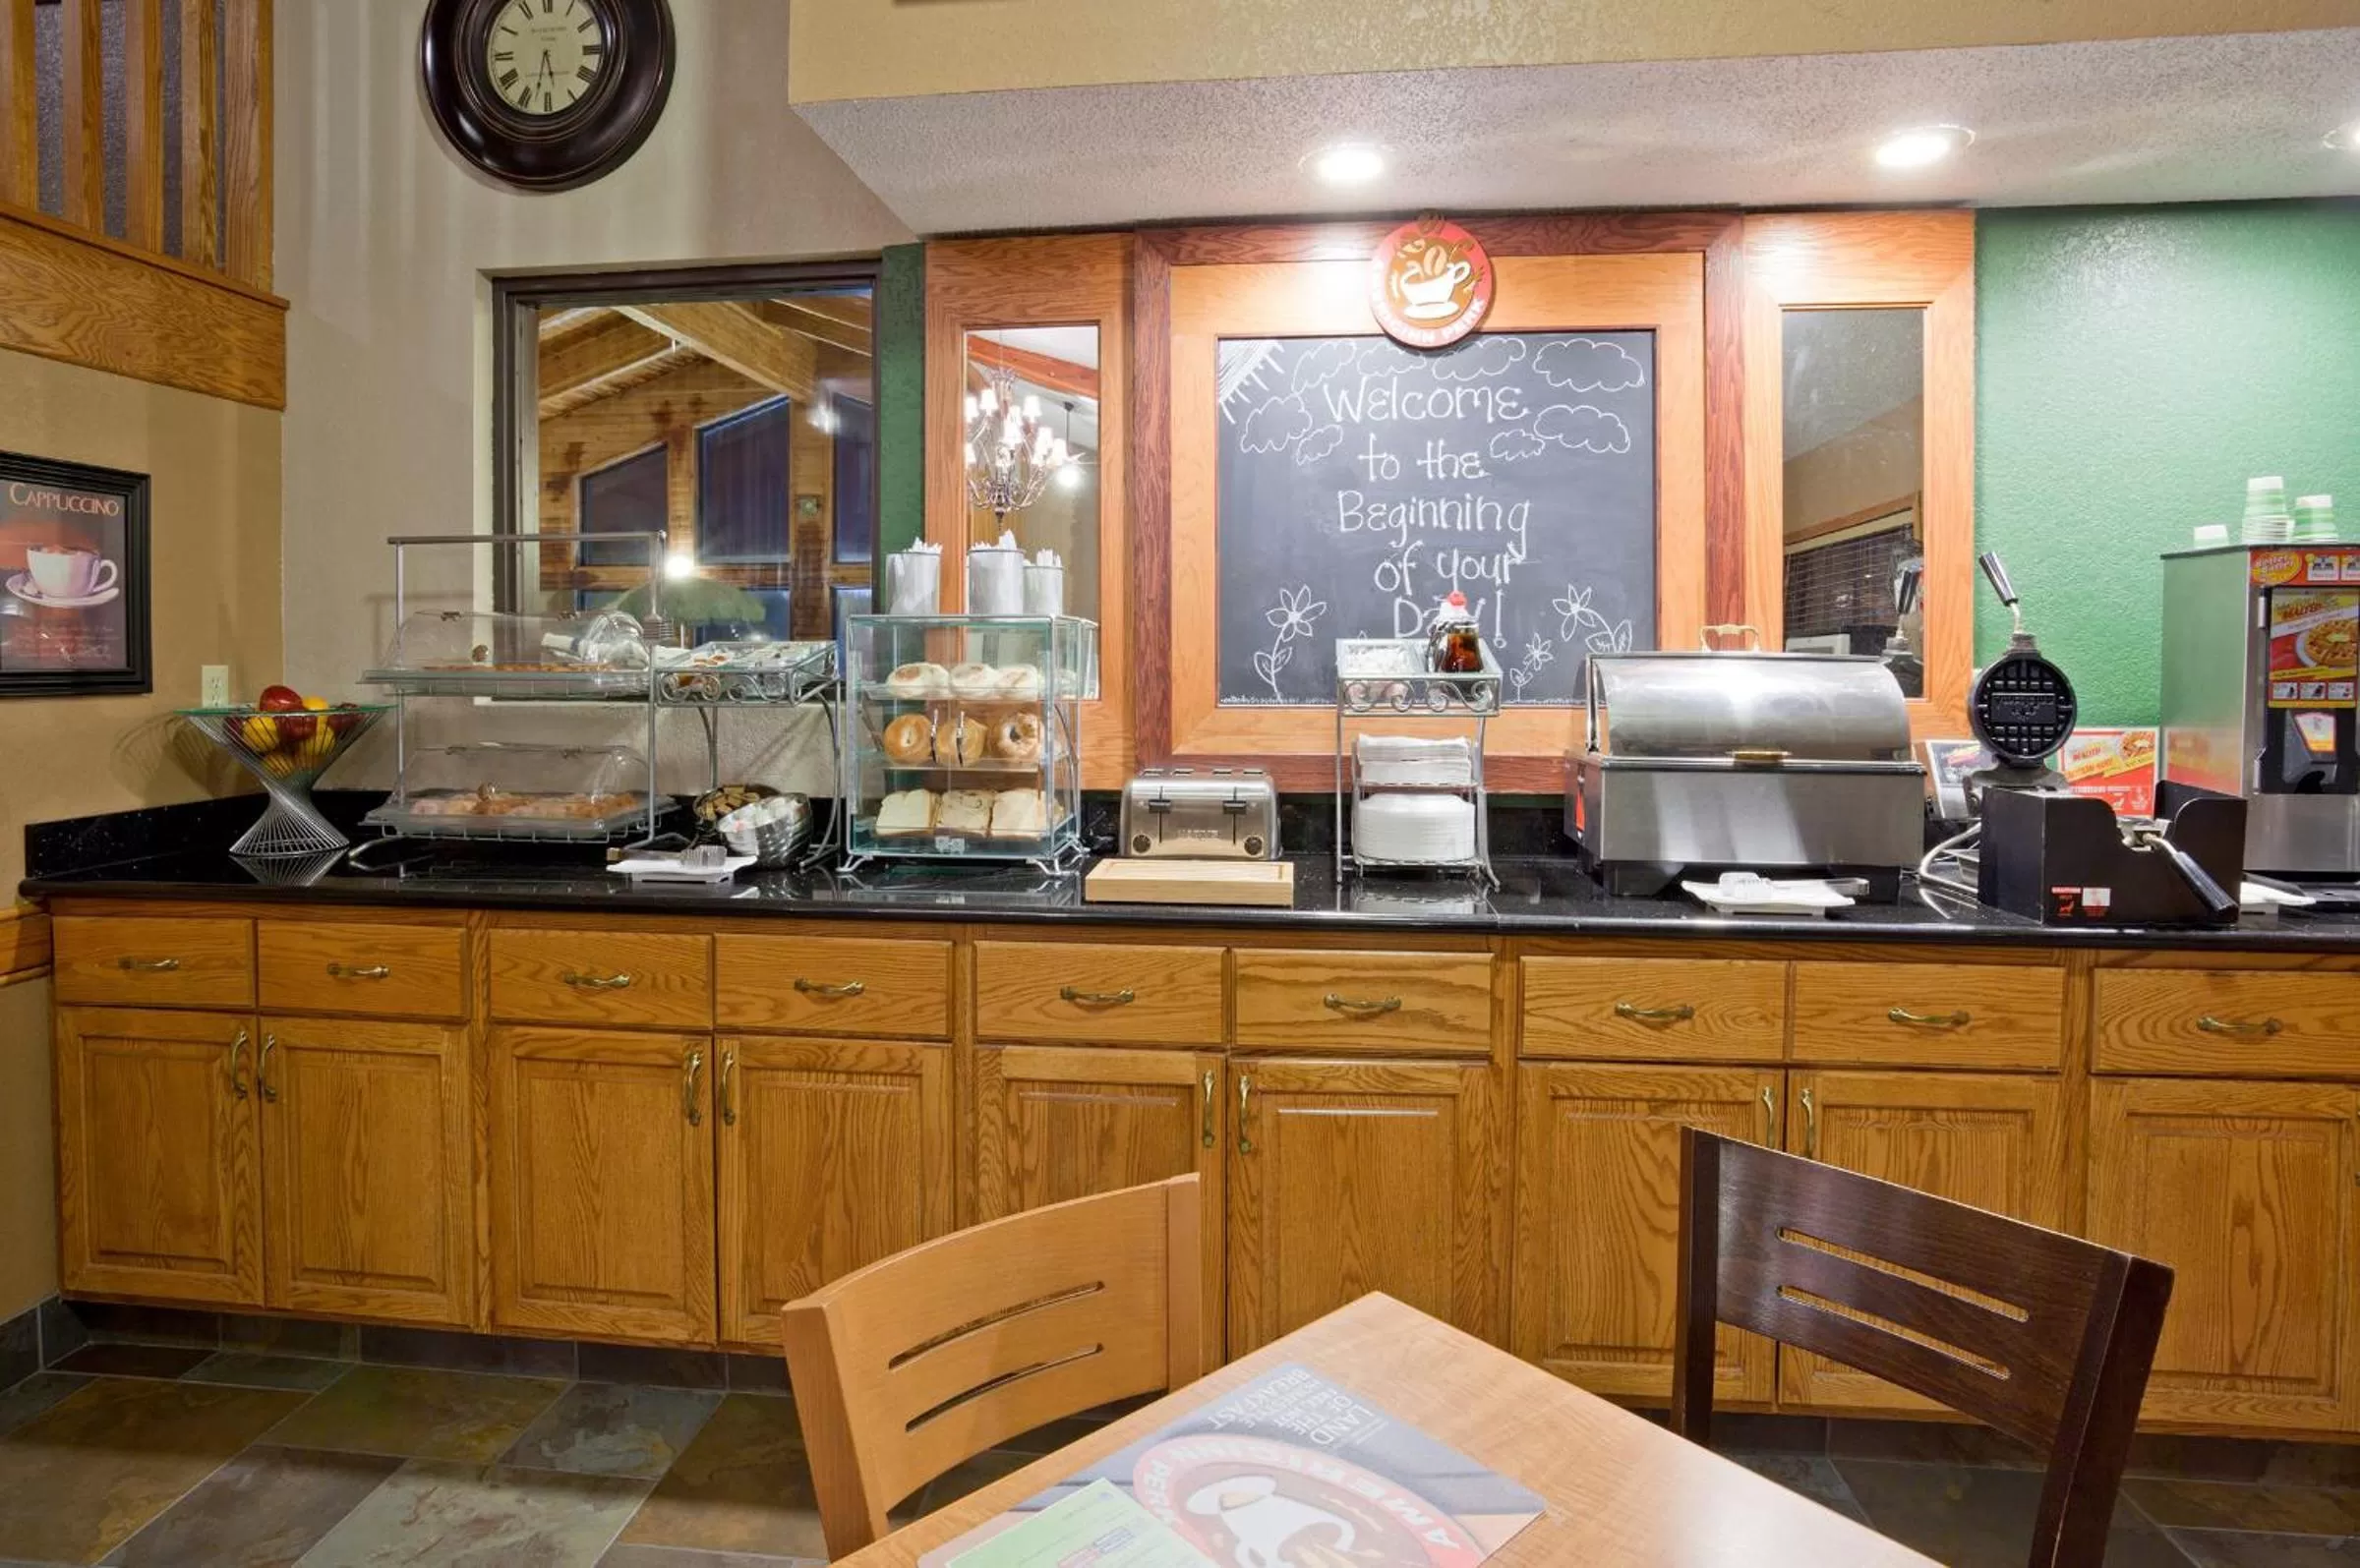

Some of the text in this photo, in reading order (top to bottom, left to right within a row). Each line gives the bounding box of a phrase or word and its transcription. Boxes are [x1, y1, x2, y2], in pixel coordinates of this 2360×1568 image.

[1323, 377, 1530, 424] Welcome
[1357, 433, 1490, 483] to the
[10, 483, 119, 517] CAPPUCCINO
[1336, 490, 1530, 563] Beginning
[1375, 540, 1524, 595] of your
[1207, 1367, 1312, 1429] BREAKFAST
[1309, 1403, 1375, 1445] LAND
